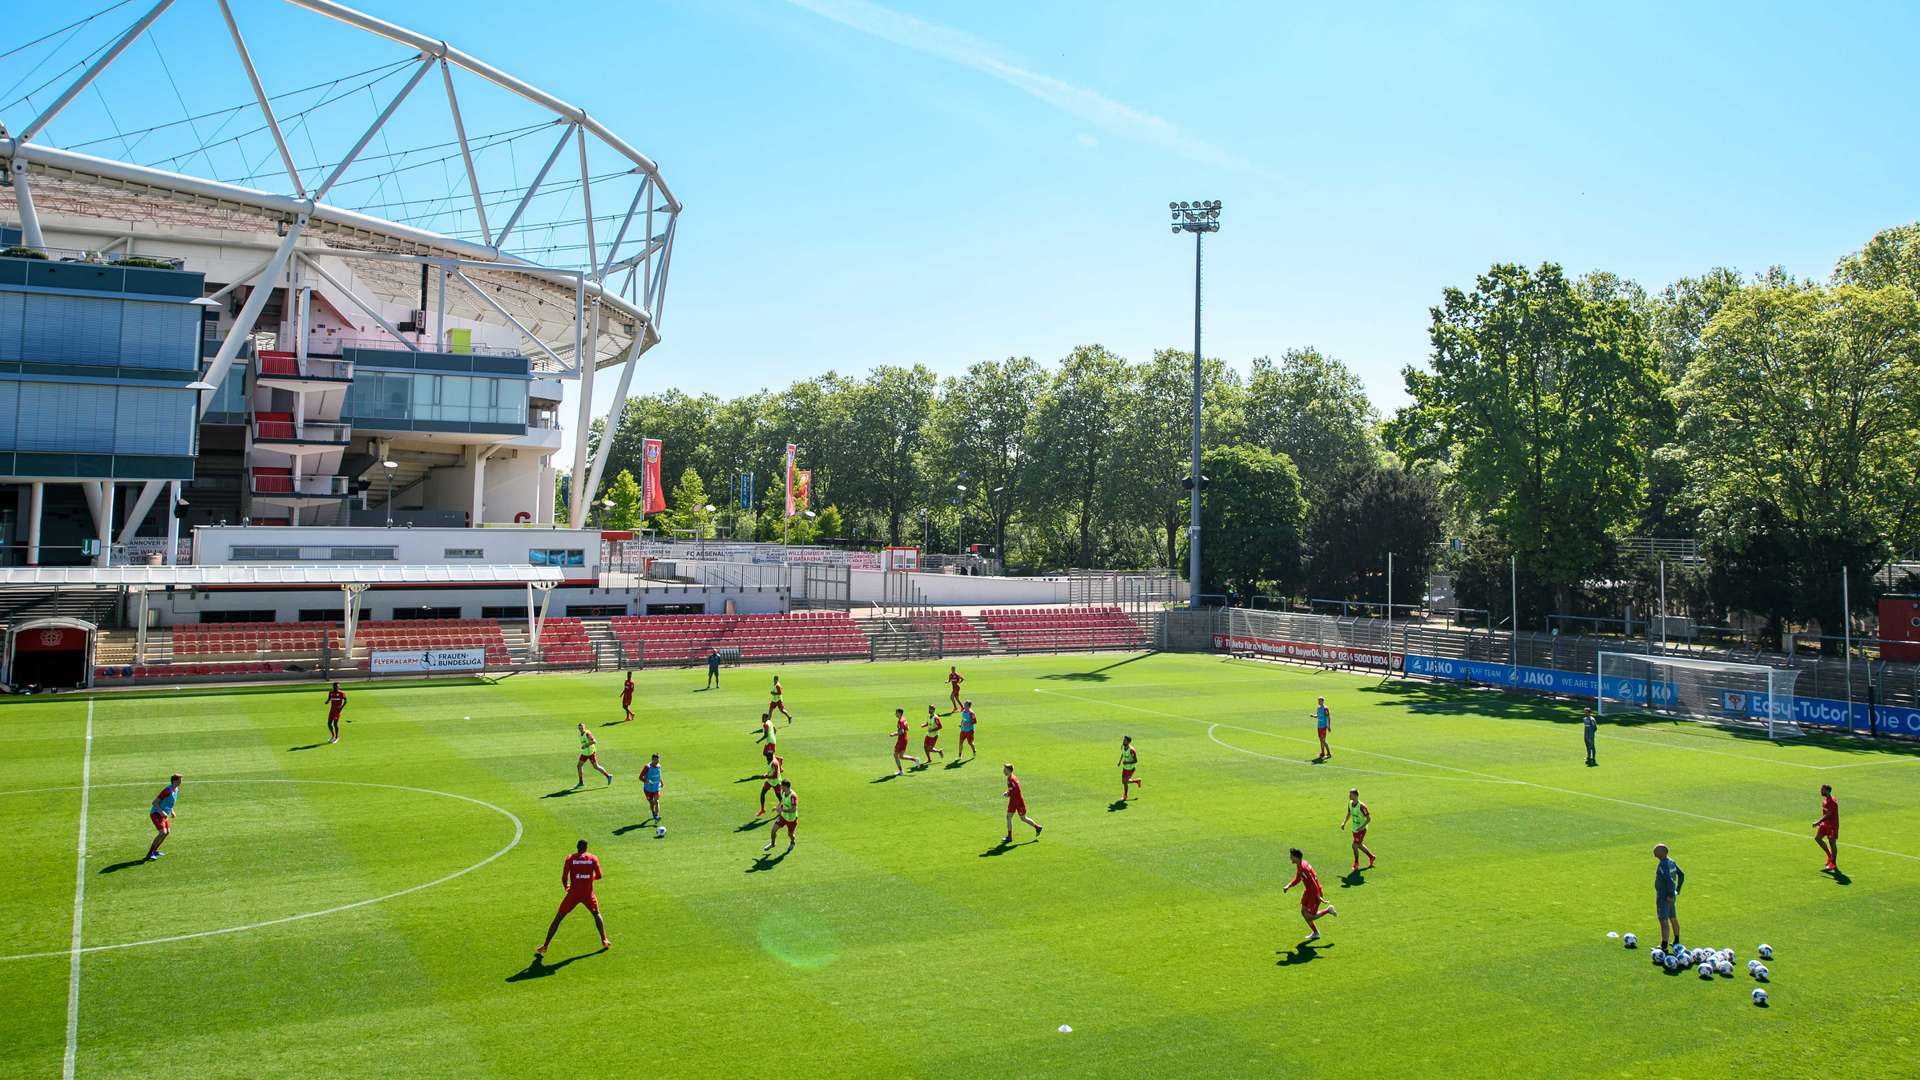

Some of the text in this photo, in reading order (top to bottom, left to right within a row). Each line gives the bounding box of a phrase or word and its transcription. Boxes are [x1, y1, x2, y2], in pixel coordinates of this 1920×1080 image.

[1225, 639, 1244, 648] Tikets
[1296, 646, 1329, 659] bayer04.e
[1355, 653, 1372, 663] 5000
[1372, 655, 1388, 666] 1904
[374, 658, 418, 666] FLYERALARM
[438, 659, 482, 667] BUNDESLIGA
[1424, 660, 1453, 674] JAKO
[1523, 671, 1554, 686] JAKO
[1561, 678, 1573, 687] WE
[1573, 679, 1589, 689] ARE
